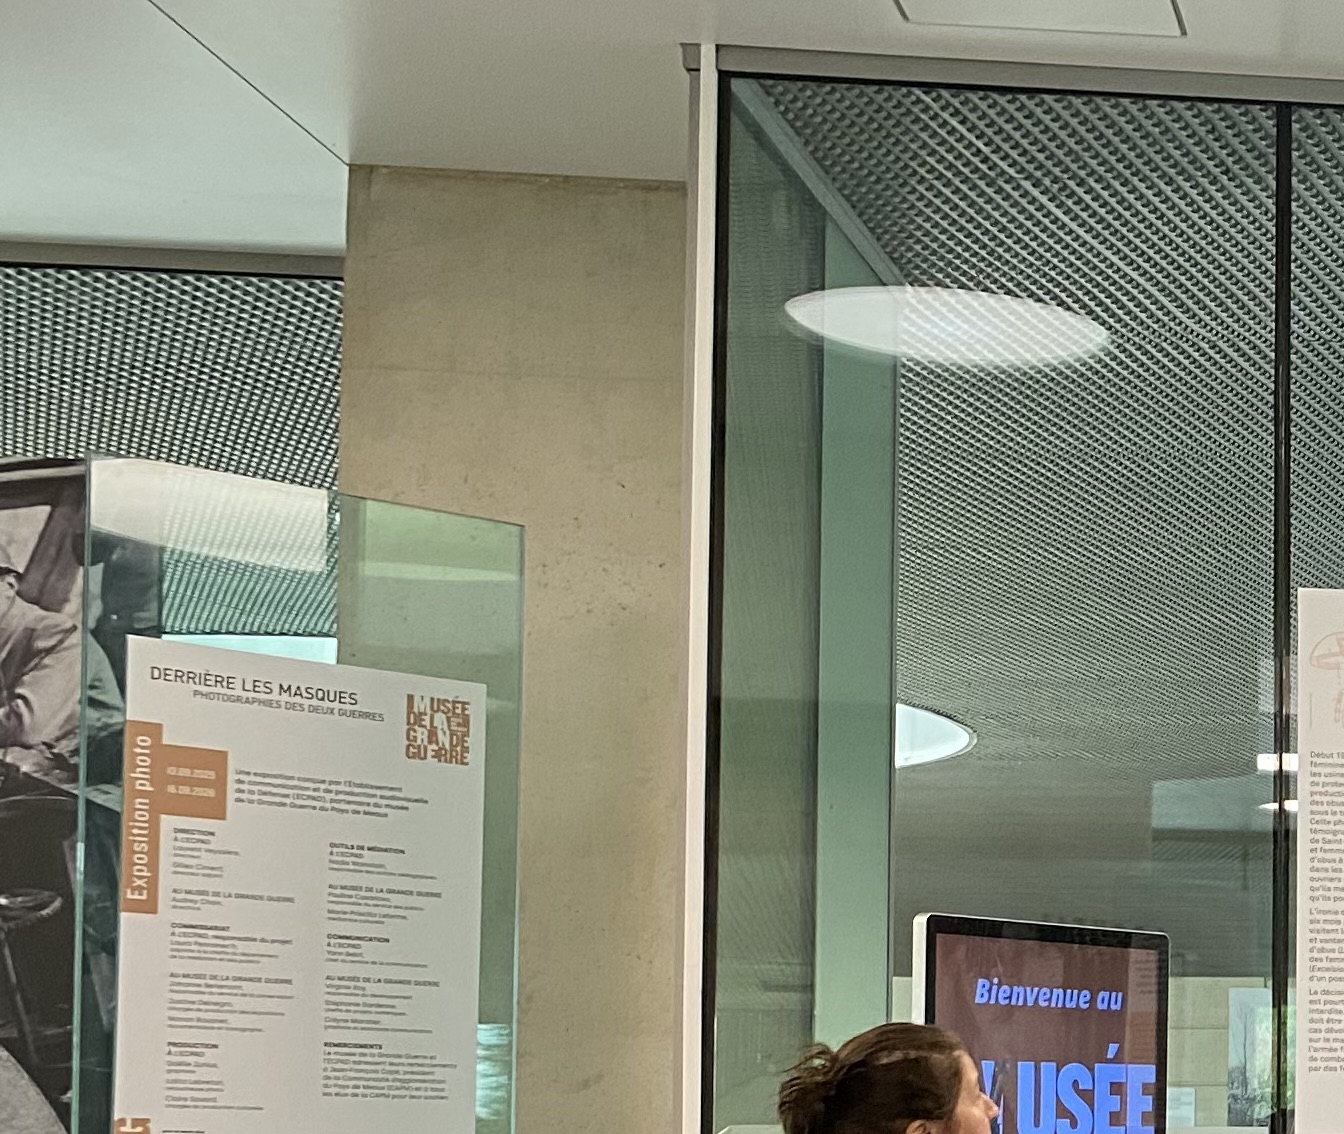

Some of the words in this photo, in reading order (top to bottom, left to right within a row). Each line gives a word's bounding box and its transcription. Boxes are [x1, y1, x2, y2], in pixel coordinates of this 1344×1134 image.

[150, 666, 236, 690] DERRIÈRE
[241, 678, 273, 695] LES
[278, 683, 359, 706] MASQUES
[192, 689, 282, 710] PHOTOGRAPHIES
[284, 700, 305, 713] DES
[307, 702, 335, 717] DEUX
[337, 705, 385, 722] GUERRES
[406, 711, 428, 728] DE
[407, 694, 471, 716] MUSÉE
[406, 726, 470, 749] GRANDE
[129, 735, 154, 792] photo
[405, 743, 470, 766] GUERRE
[126, 798, 152, 901] Exposition
[974, 978, 1092, 1010] Bienvenue
[1096, 991, 1124, 1011] au
